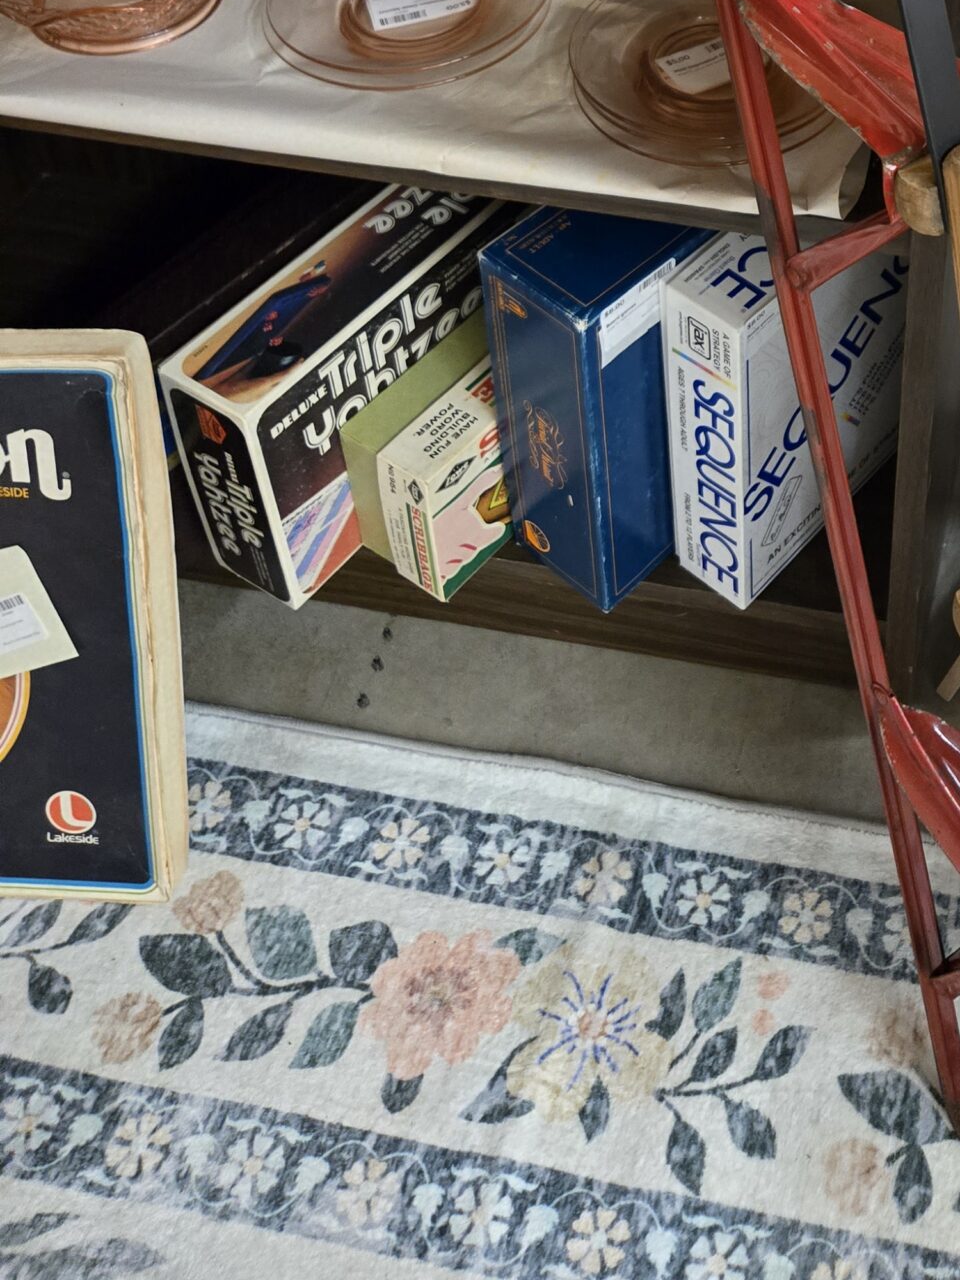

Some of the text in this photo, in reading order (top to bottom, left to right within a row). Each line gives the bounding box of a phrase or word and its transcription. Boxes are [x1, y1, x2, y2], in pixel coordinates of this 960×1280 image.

[318, 282, 443, 400] Triple
[689, 319, 709, 352] jax
[711, 328, 722, 372] STRATEGY
[722, 341, 731, 363] GAME
[678, 366, 686, 387] AGES
[723, 363, 732, 379] OF
[269, 383, 329, 440] DELUXE
[429, 408, 463, 436] WORD
[678, 393, 688, 427] THROUGH
[423, 412, 471, 453] BUILDING
[429, 416, 479, 459] HAVE FUN
[679, 428, 688, 452] ADULT
[194, 451, 242, 556] Yahtzee
[692, 379, 739, 594] SEQUENCE
[225, 479, 265, 549] Triple
[767, 543, 782, 565] AN
[783, 503, 822, 546] EXCITIN
[411, 505, 433, 593] SCRIBBAGE
[46, 830, 100, 845] Lakeside
